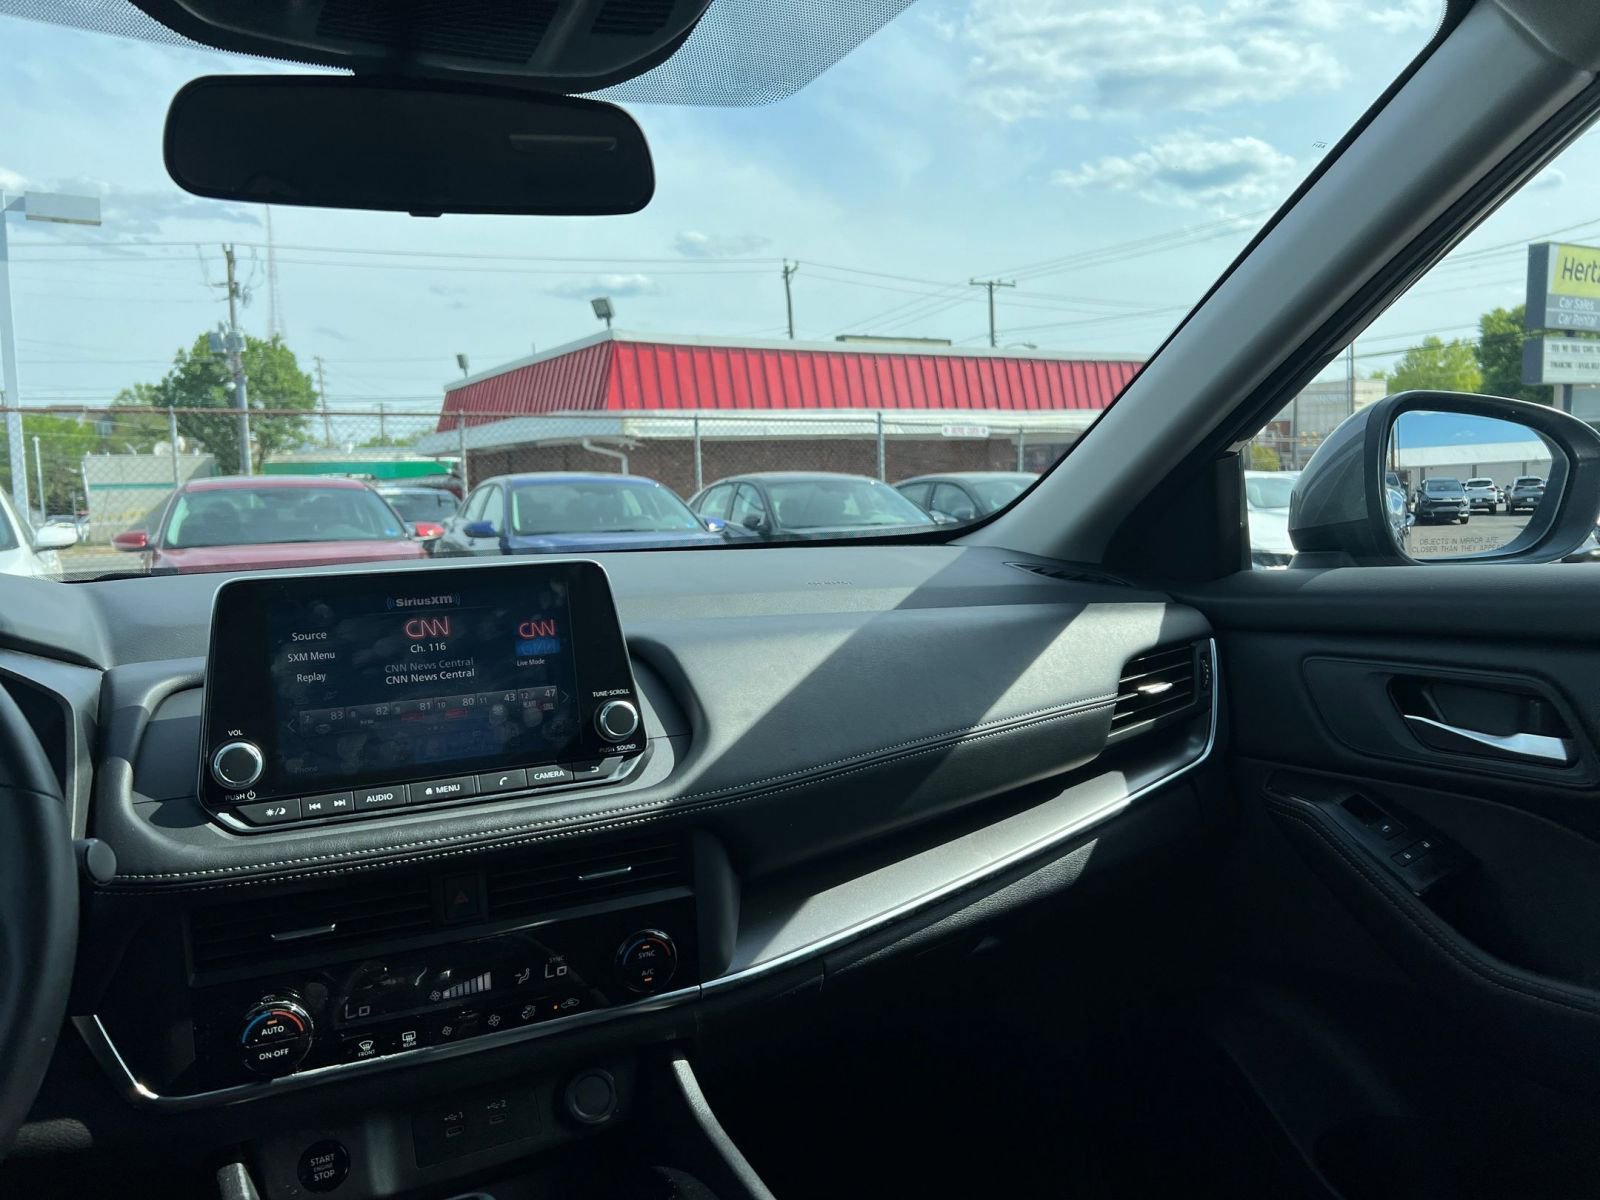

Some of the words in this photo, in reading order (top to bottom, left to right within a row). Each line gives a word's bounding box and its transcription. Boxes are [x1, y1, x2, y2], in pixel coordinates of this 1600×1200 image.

[1559, 297, 1573, 308] Car
[1420, 537, 1452, 546] OBJECTS
[1453, 537, 1458, 545] IN
[1460, 537, 1485, 545] MIRROR
[1412, 545, 1439, 553] CLOSER
[1441, 544, 1458, 552] THAN
[1461, 544, 1476, 552] THEY
[406, 616, 449, 638] CNN
[519, 619, 555, 638] CNN
[291, 631, 327, 642] Source
[410, 644, 426, 653] Ch.
[429, 642, 447, 652] 116
[287, 652, 308, 663] SXM
[310, 651, 336, 661] Menu
[517, 659, 529, 667] Live
[529, 657, 545, 665] Mode
[385, 664, 407, 674] CNN
[410, 661, 437, 671] News
[438, 657, 474, 669] Central
[296, 671, 327, 683] Replay
[385, 675, 408, 685] CNN
[411, 672, 438, 682] News
[439, 668, 475, 679] Central
[330, 711, 344, 721] 83
[375, 706, 389, 716] 82
[419, 702, 431, 711] 81
[462, 697, 475, 706] 80
[504, 693, 516, 702] 43
[544, 688, 556, 697] 47
[228, 729, 243, 737] VOL
[616, 743, 636, 752] SOUND
[534, 769, 565, 780] CAMERA
[435, 783, 461, 794] MENU
[366, 792, 394, 803] AUDIO
[638, 949, 656, 960] SYNC
[641, 967, 655, 976] A/C
[261, 1025, 285, 1036] AUTO
[358, 1049, 375, 1057] FRONT
[310, 1153, 335, 1167] START
[314, 1169, 335, 1181] STOP
